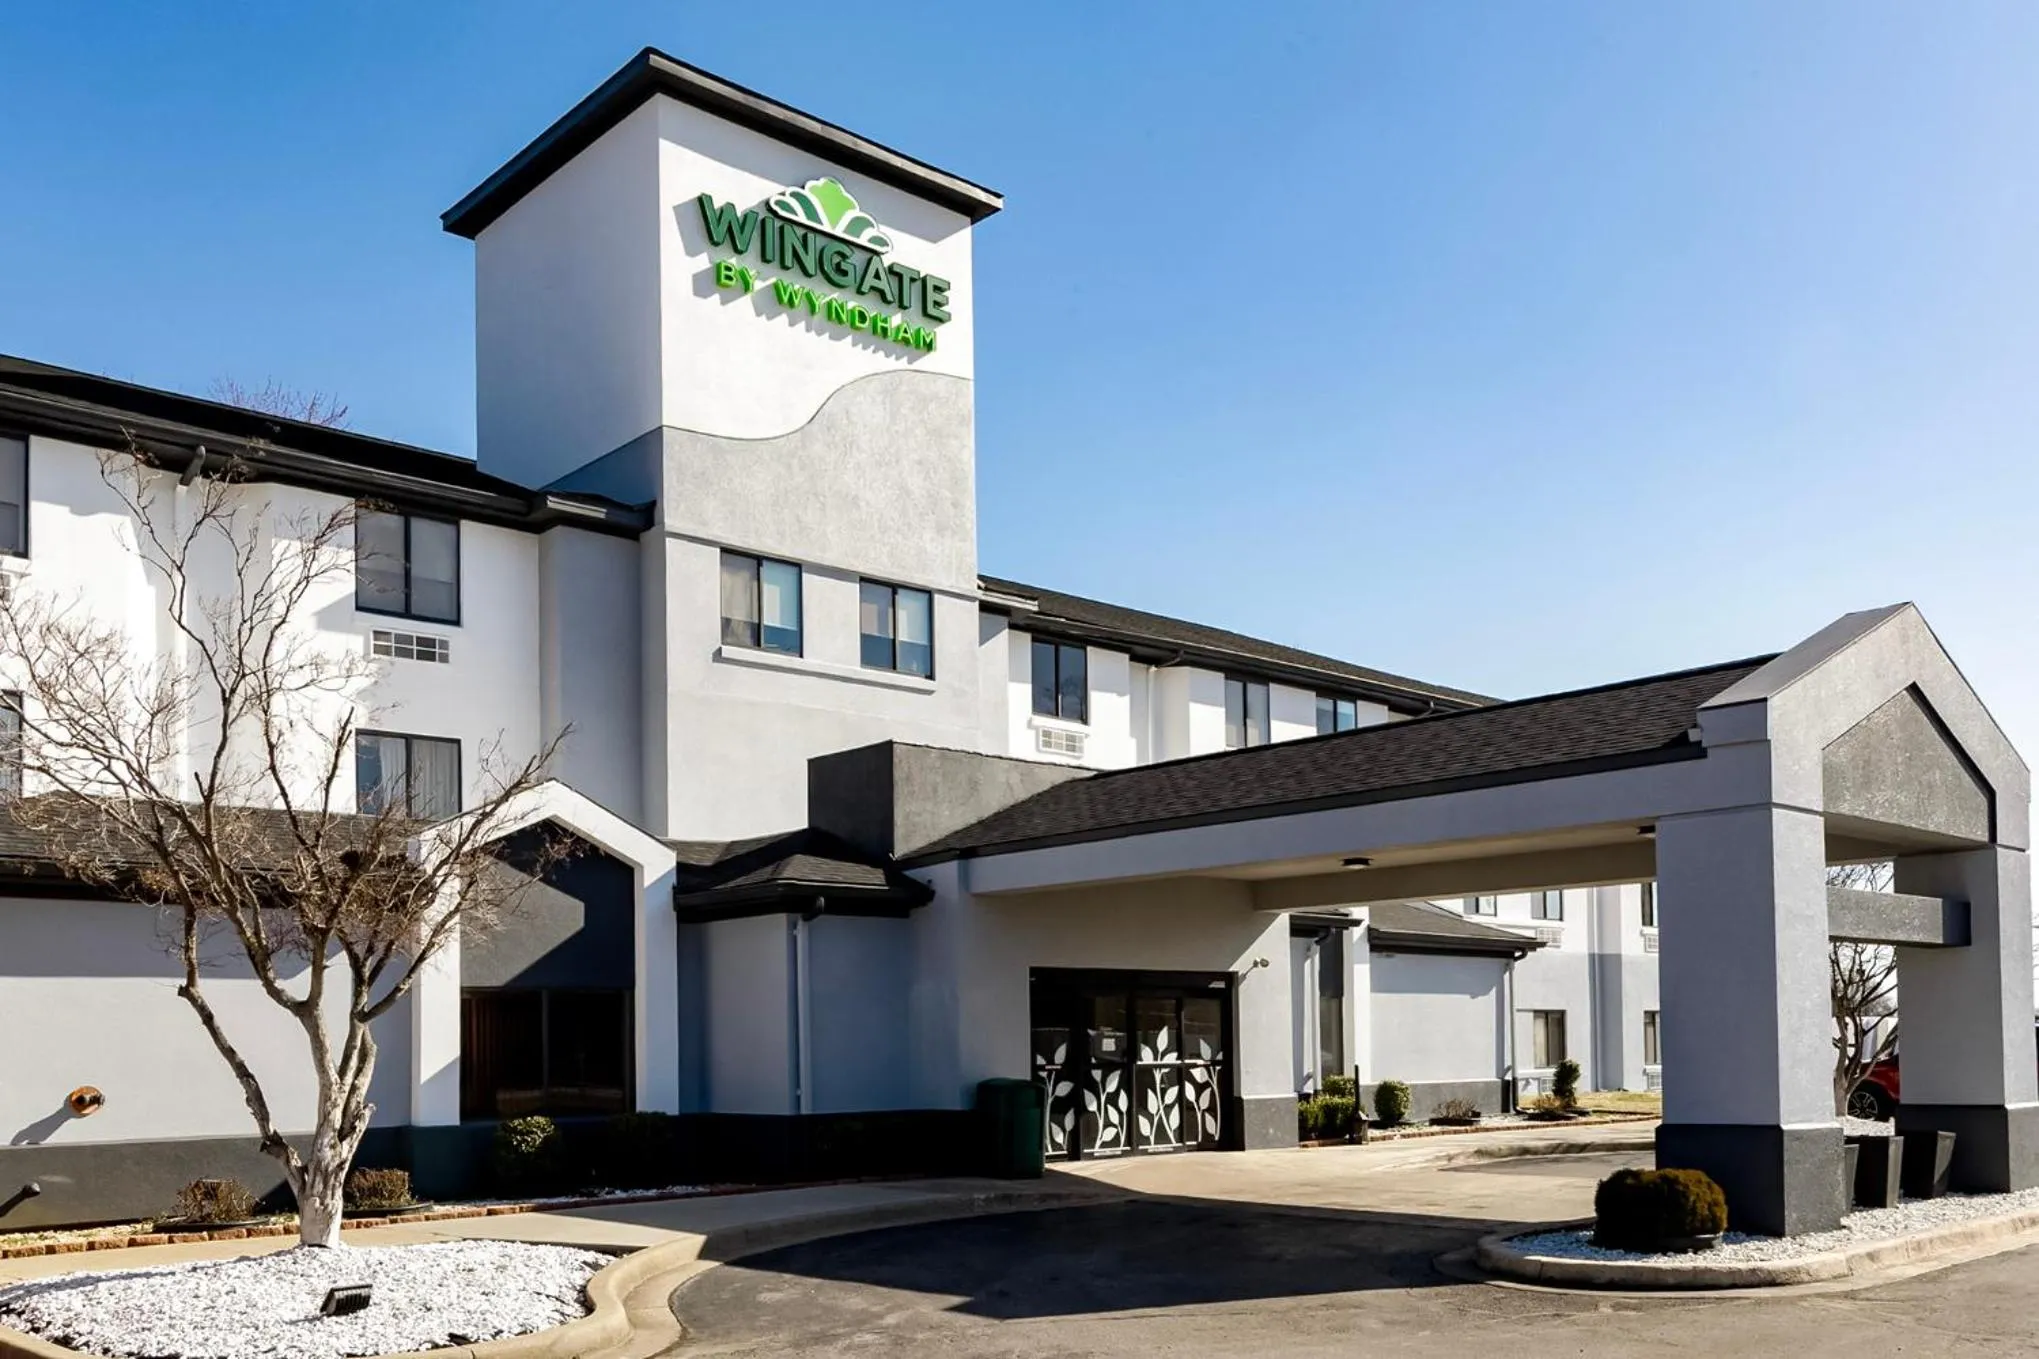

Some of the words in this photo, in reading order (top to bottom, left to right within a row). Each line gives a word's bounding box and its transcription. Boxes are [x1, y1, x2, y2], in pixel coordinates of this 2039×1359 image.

[698, 193, 951, 323] WINGATE
[716, 260, 758, 295] BY
[773, 279, 937, 352] WYNDHAM
